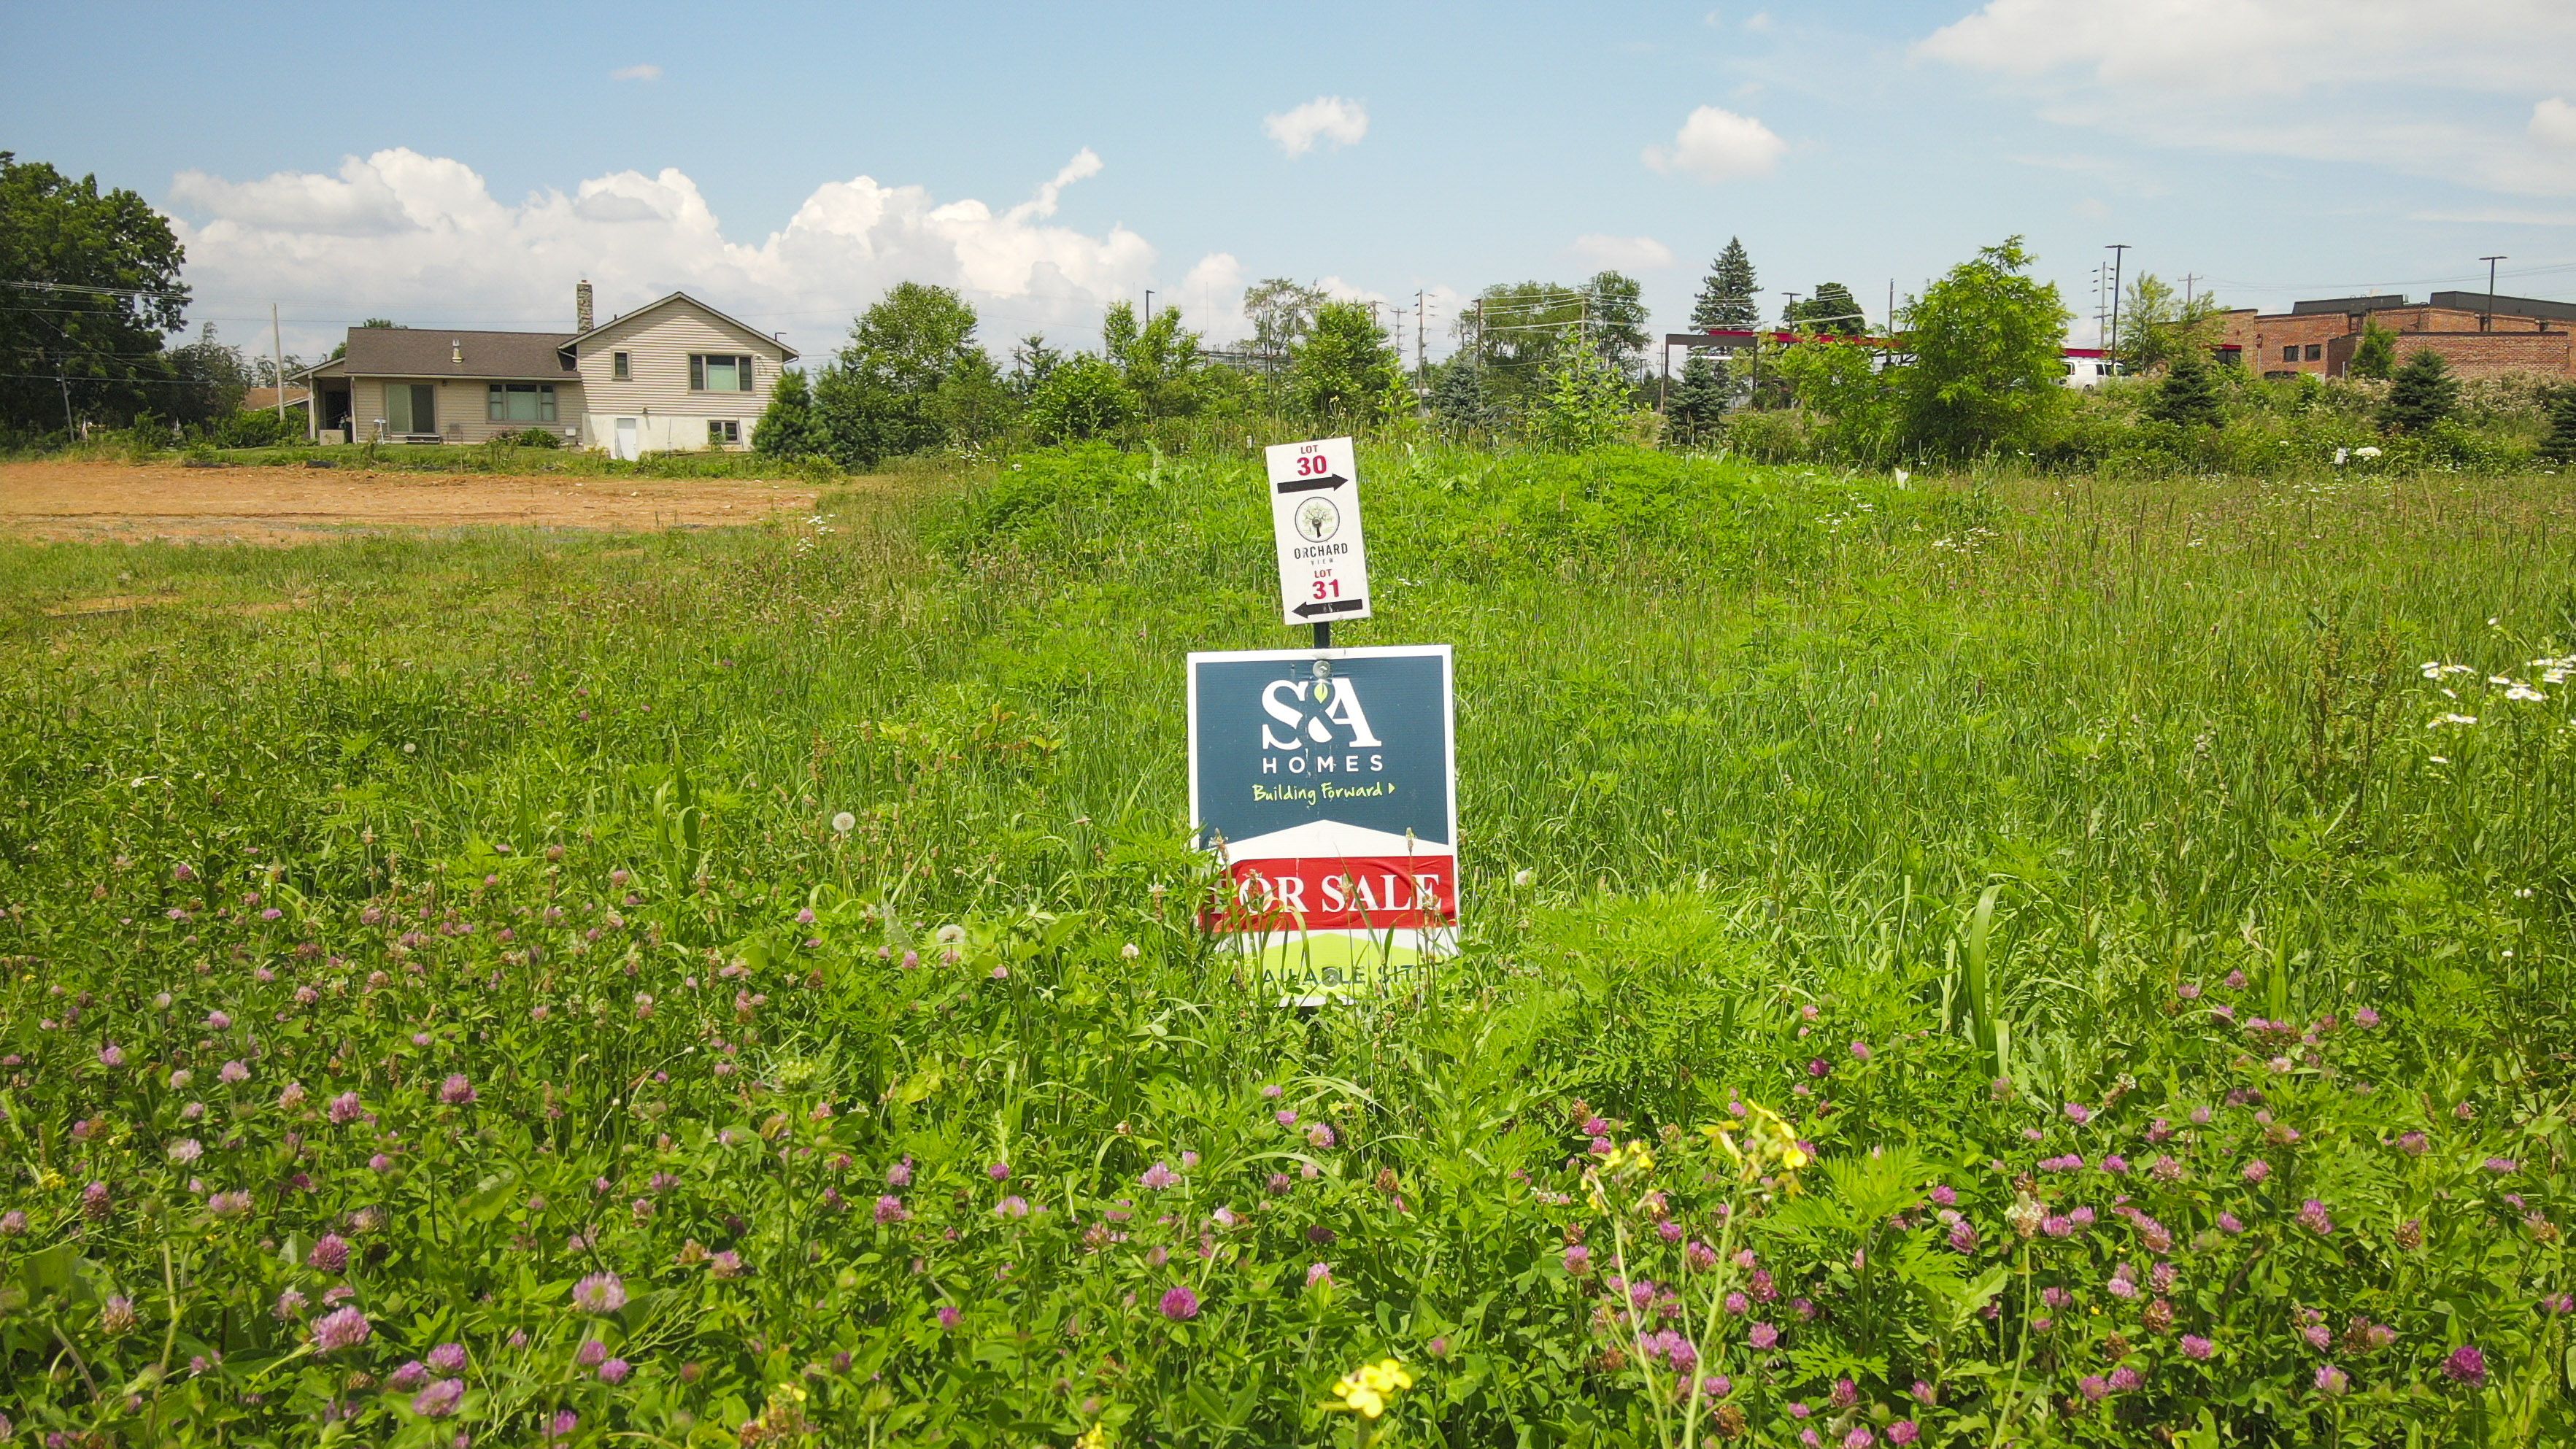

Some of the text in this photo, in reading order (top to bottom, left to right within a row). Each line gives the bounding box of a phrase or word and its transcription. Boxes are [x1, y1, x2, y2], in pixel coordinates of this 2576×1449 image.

[1300, 444, 1319, 455] LOT
[1297, 455, 1327, 476] 30
[1294, 543, 1348, 559] ORCHARD
[1314, 568, 1333, 578] LOT
[1312, 579, 1340, 600] 31
[1262, 678, 1381, 751] S&A
[1262, 754, 1384, 775] HOMES
[1252, 781, 1383, 805] Building Forward
[1321, 873, 1442, 912] SALE
[1227, 965, 1366, 986] AILALE
